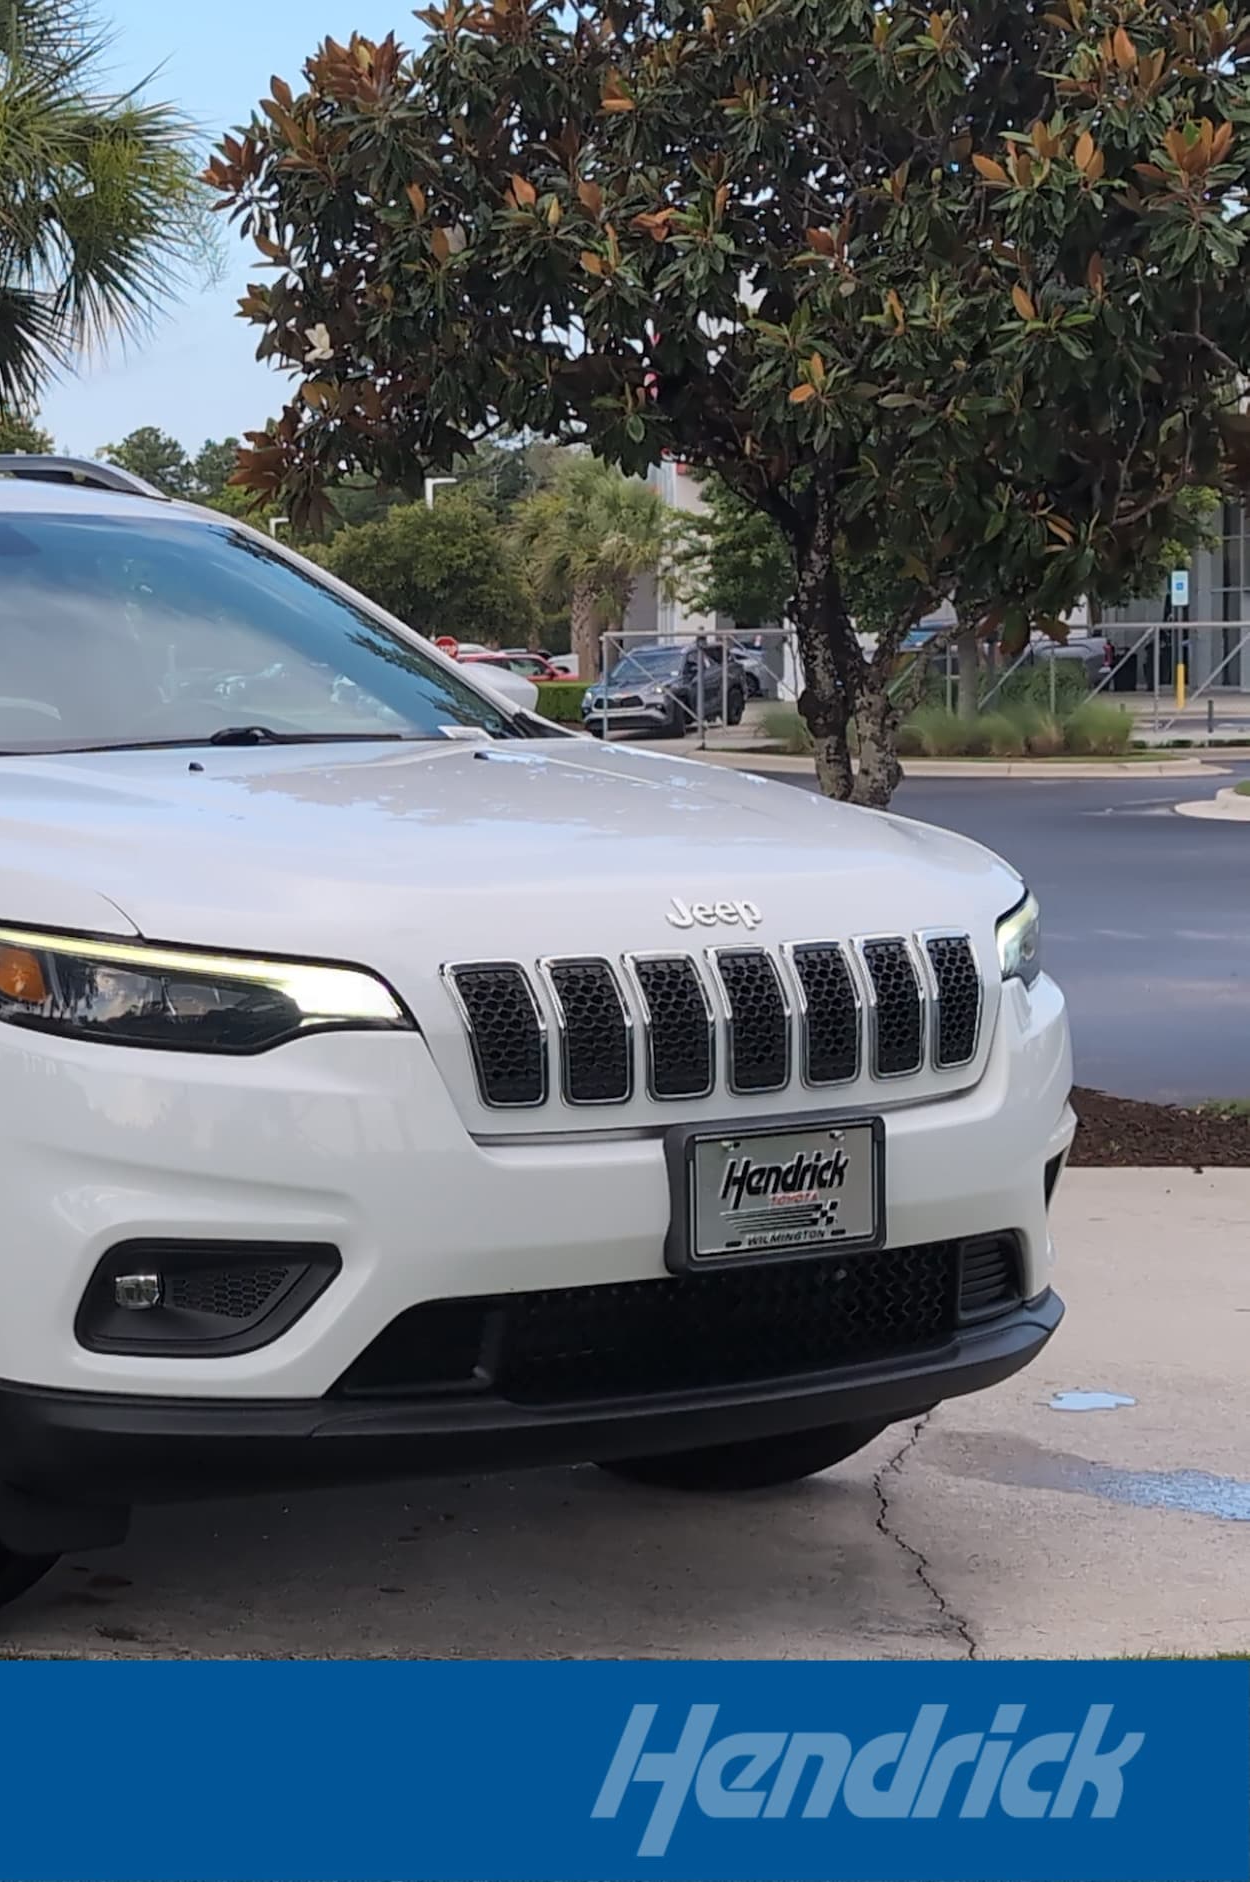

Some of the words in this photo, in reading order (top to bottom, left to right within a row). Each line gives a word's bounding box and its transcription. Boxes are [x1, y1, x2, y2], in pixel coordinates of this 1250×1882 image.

[665, 897, 763, 931] Jeep
[720, 1149, 850, 1211] Hendrick
[770, 1191, 818, 1206] TOYOTA
[747, 1229, 825, 1246] WILMINGTON
